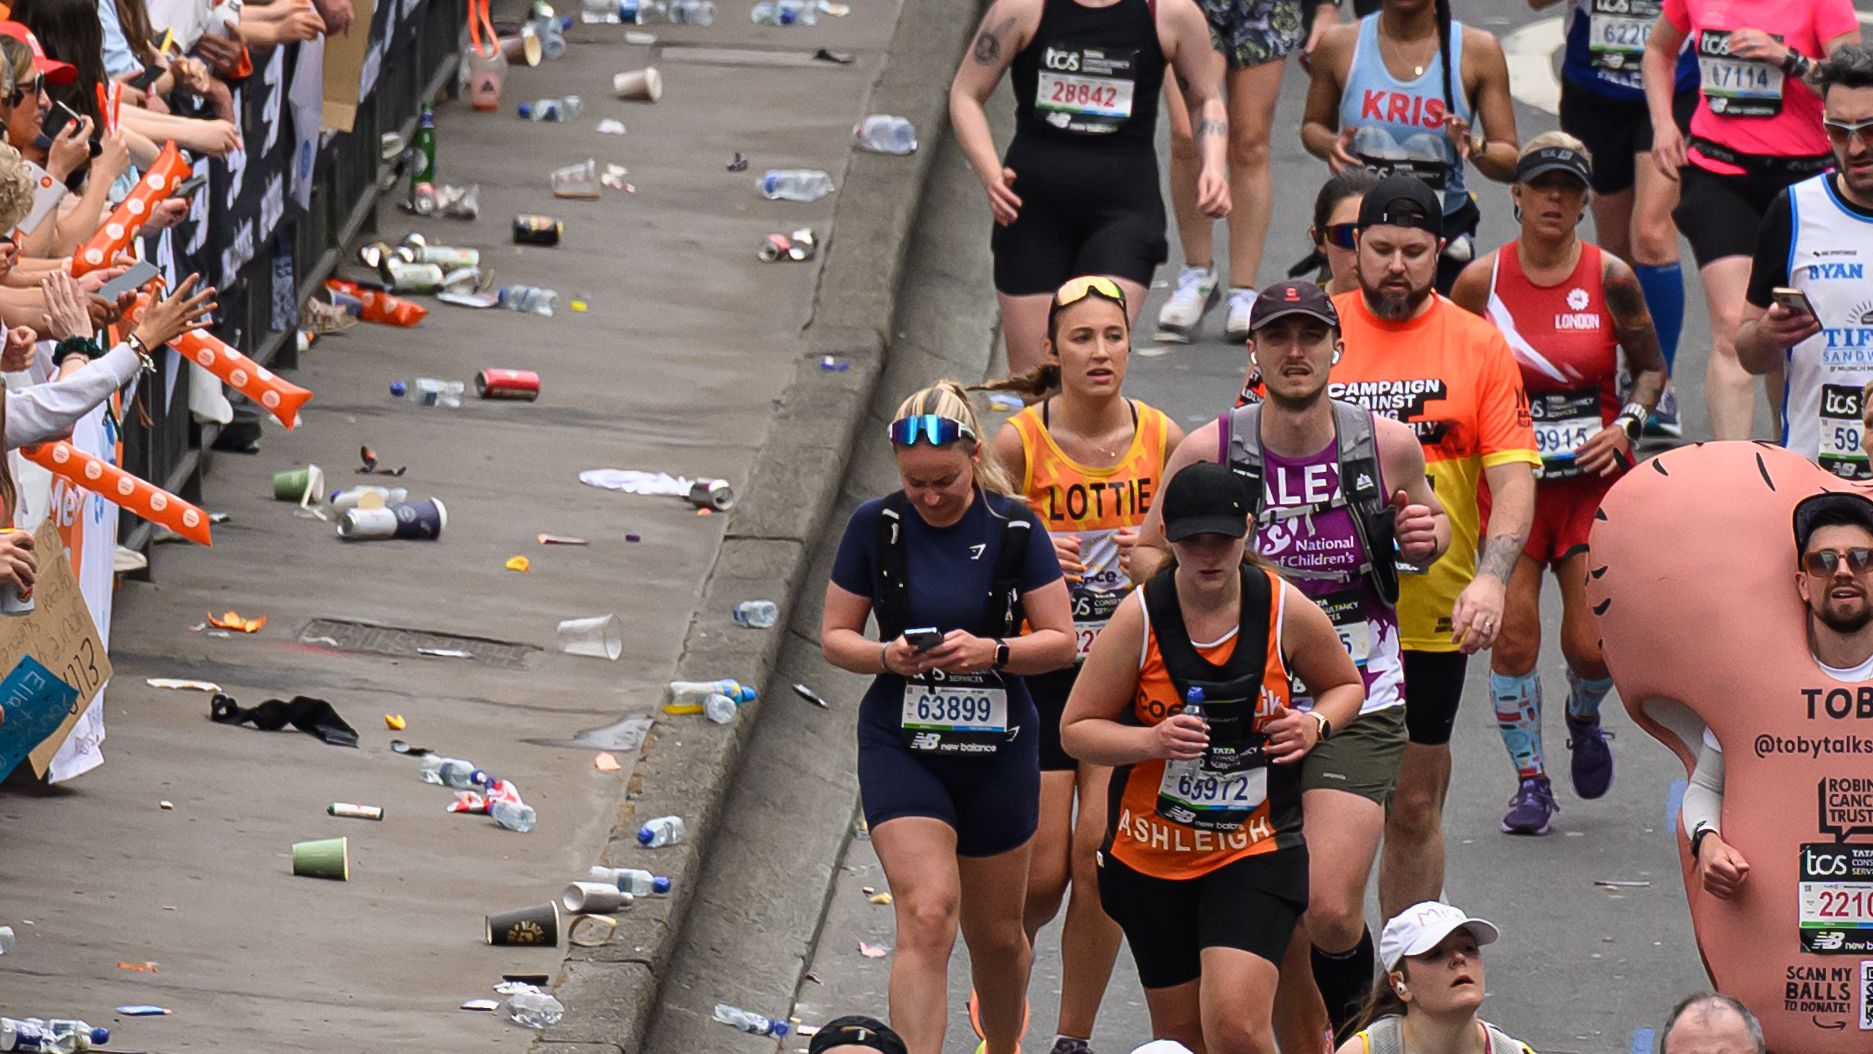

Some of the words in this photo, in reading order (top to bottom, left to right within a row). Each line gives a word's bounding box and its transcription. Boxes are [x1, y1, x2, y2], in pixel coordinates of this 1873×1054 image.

[1046, 47, 1079, 71] tcs
[1362, 89, 1446, 129] KRIS
[1555, 314, 1601, 331] LONDON
[1327, 379, 1441, 399] CAMPAIGN
[1826, 388, 1858, 415] tcs
[1834, 426, 1862, 451] 59
[1049, 476, 1152, 522] LOTTIE
[1295, 535, 1355, 552] National
[1287, 551, 1355, 569] Children's
[917, 695, 992, 722] 63899
[940, 740, 960, 752] new
[960, 740, 997, 754] balance
[1212, 747, 1236, 756] TATA
[1178, 773, 1249, 801] 65972
[1118, 806, 1270, 853] ASHLEIGH
[1805, 848, 1847, 876] tcs
[1844, 941, 1866, 950] new
[1786, 965, 1828, 982] SCAN
[1831, 967, 1853, 982] MY
[1785, 981, 1852, 1000] BALLS
[1784, 1000, 1799, 1011] TO
[1799, 1000, 1851, 1013] DONATE!
